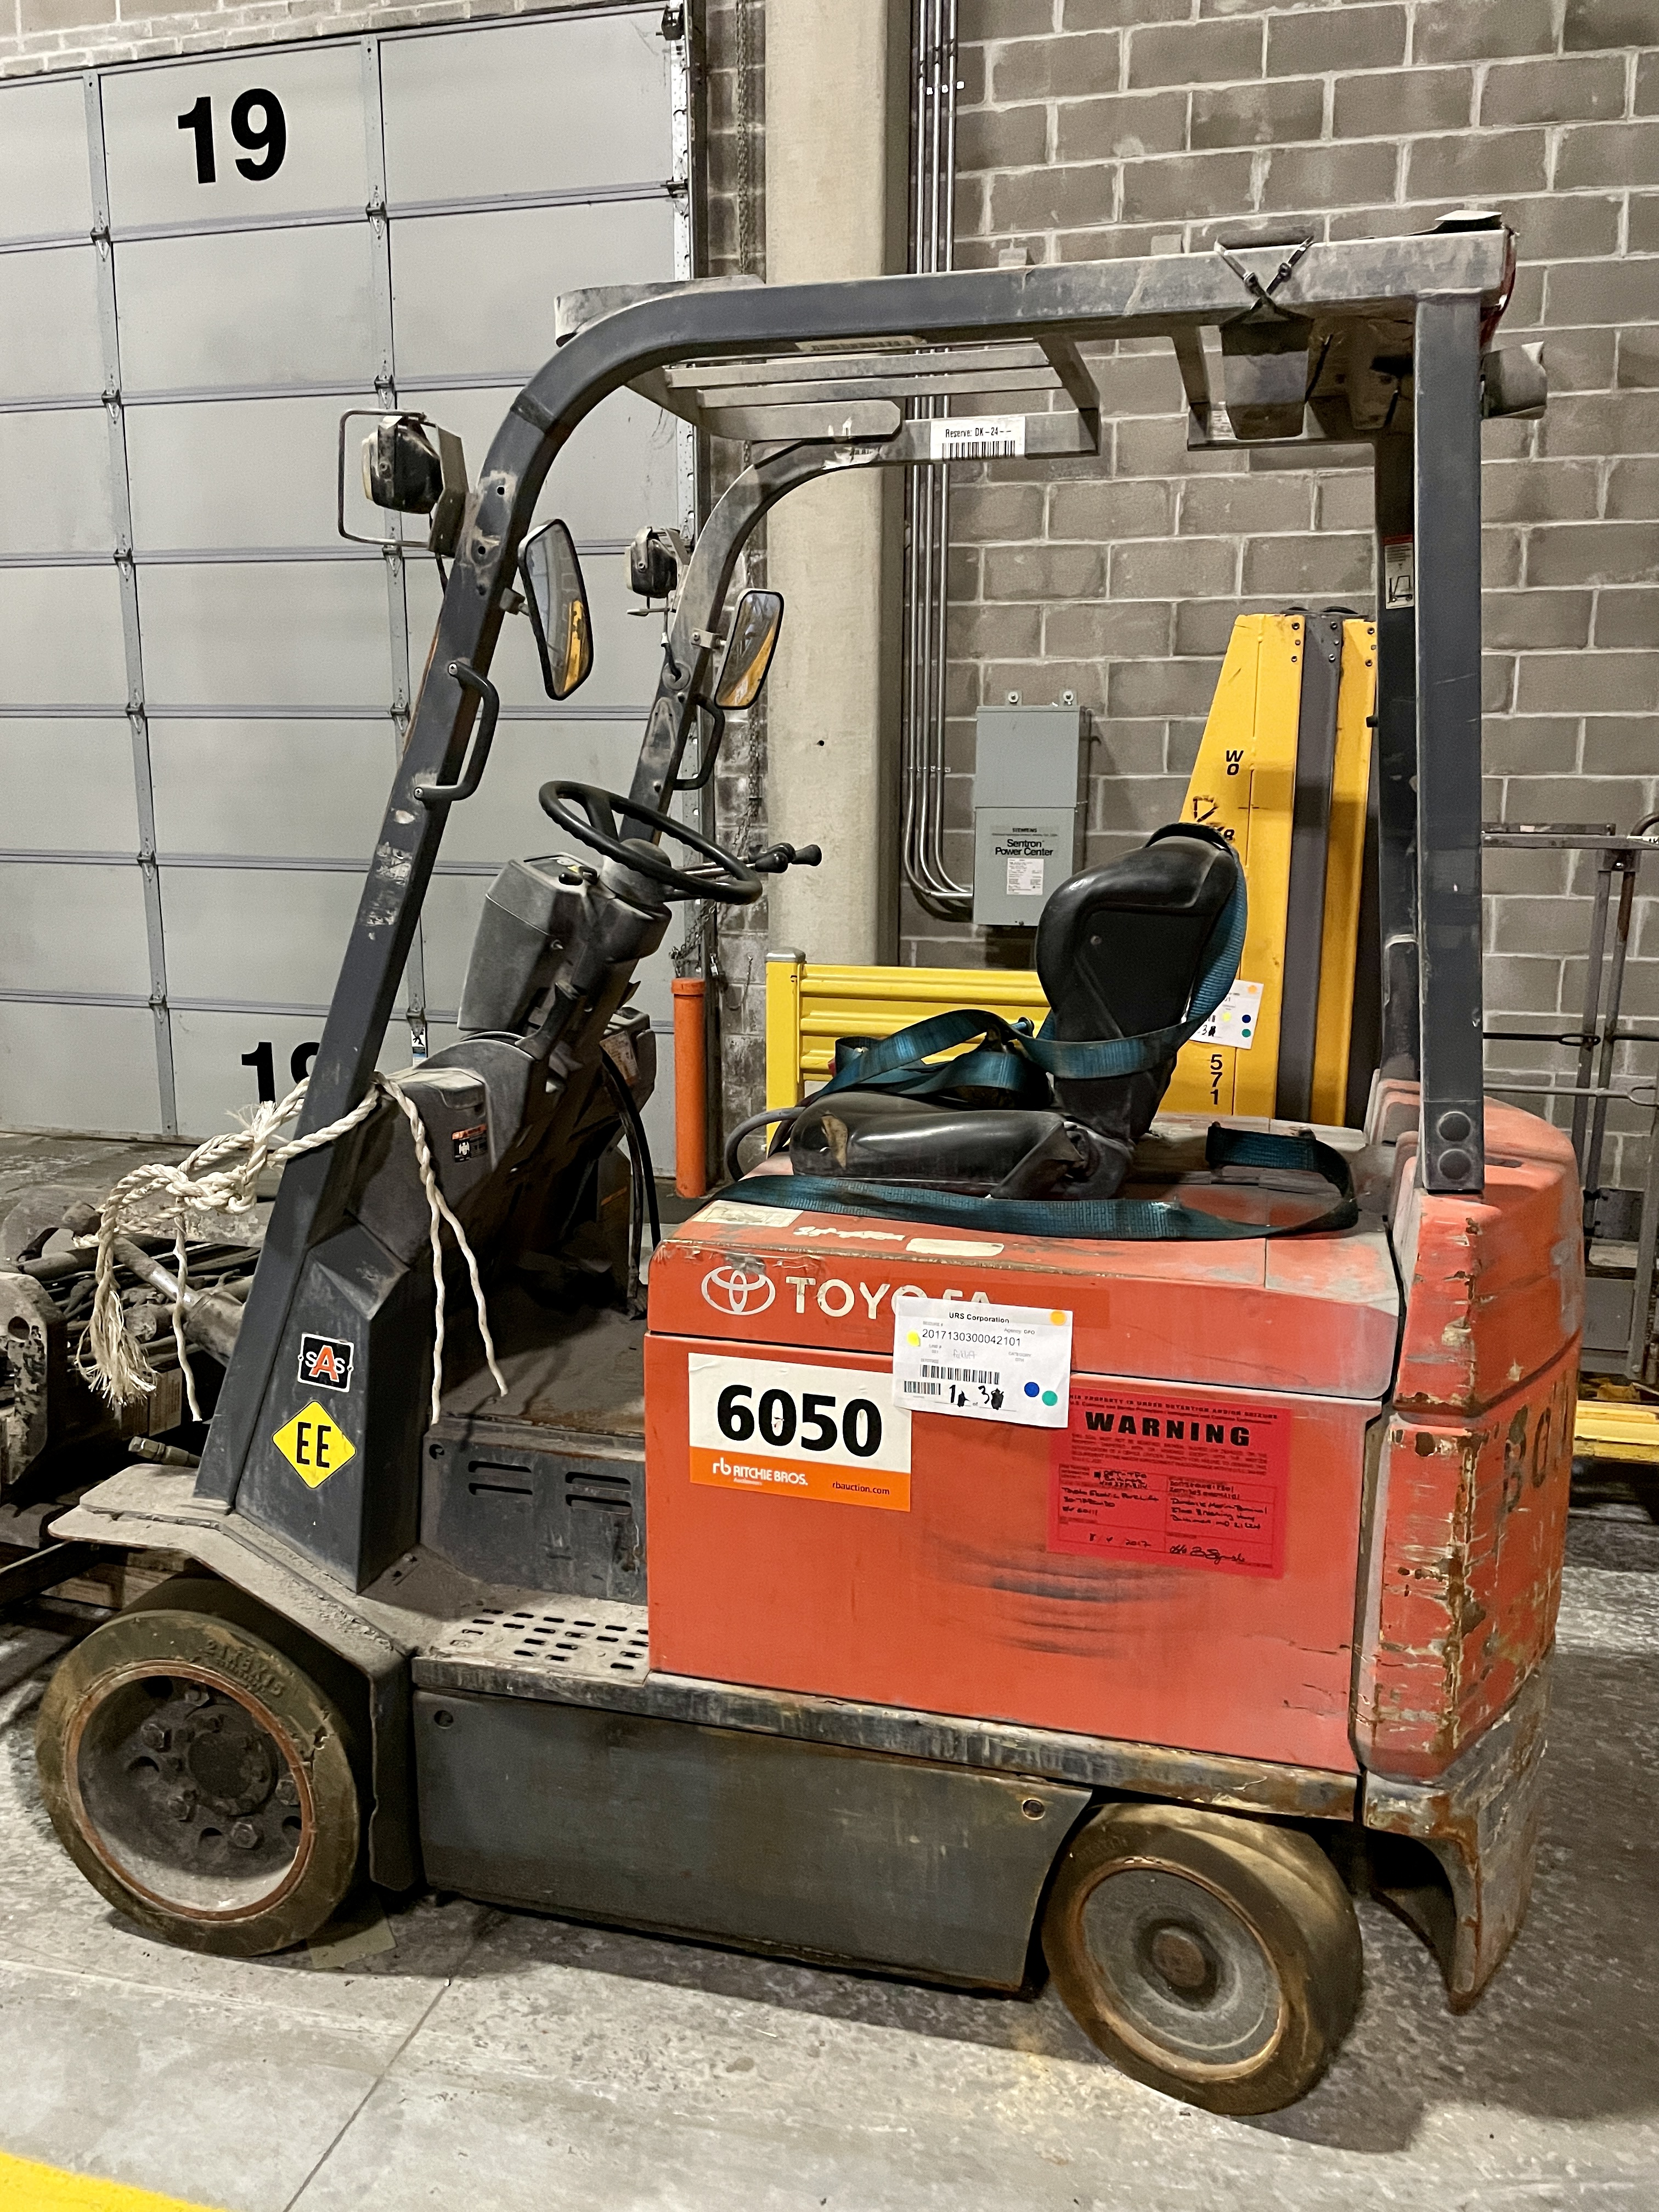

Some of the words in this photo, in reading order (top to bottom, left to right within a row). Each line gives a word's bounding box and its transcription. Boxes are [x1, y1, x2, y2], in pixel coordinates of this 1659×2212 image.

[178, 88, 287, 184] 19
[945, 428, 972, 437] Reserve:
[995, 847, 1022, 855] Power
[1024, 847, 1053, 856] Center
[1007, 839, 1042, 848] Sentron
[949, 1311, 964, 1319] URS
[967, 1313, 1009, 1324] Corporation
[922, 1329, 1021, 1346] 2017130300042101
[718, 1384, 882, 1457] 6050
[1085, 1412, 1250, 1447] WARNING
[296, 1421, 331, 1469] EE
[713, 1457, 732, 1475] rb
[733, 1465, 772, 1481] RITCHIE
[774, 1470, 809, 1486] BROS.
[832, 1481, 890, 1495] rbauction.com
